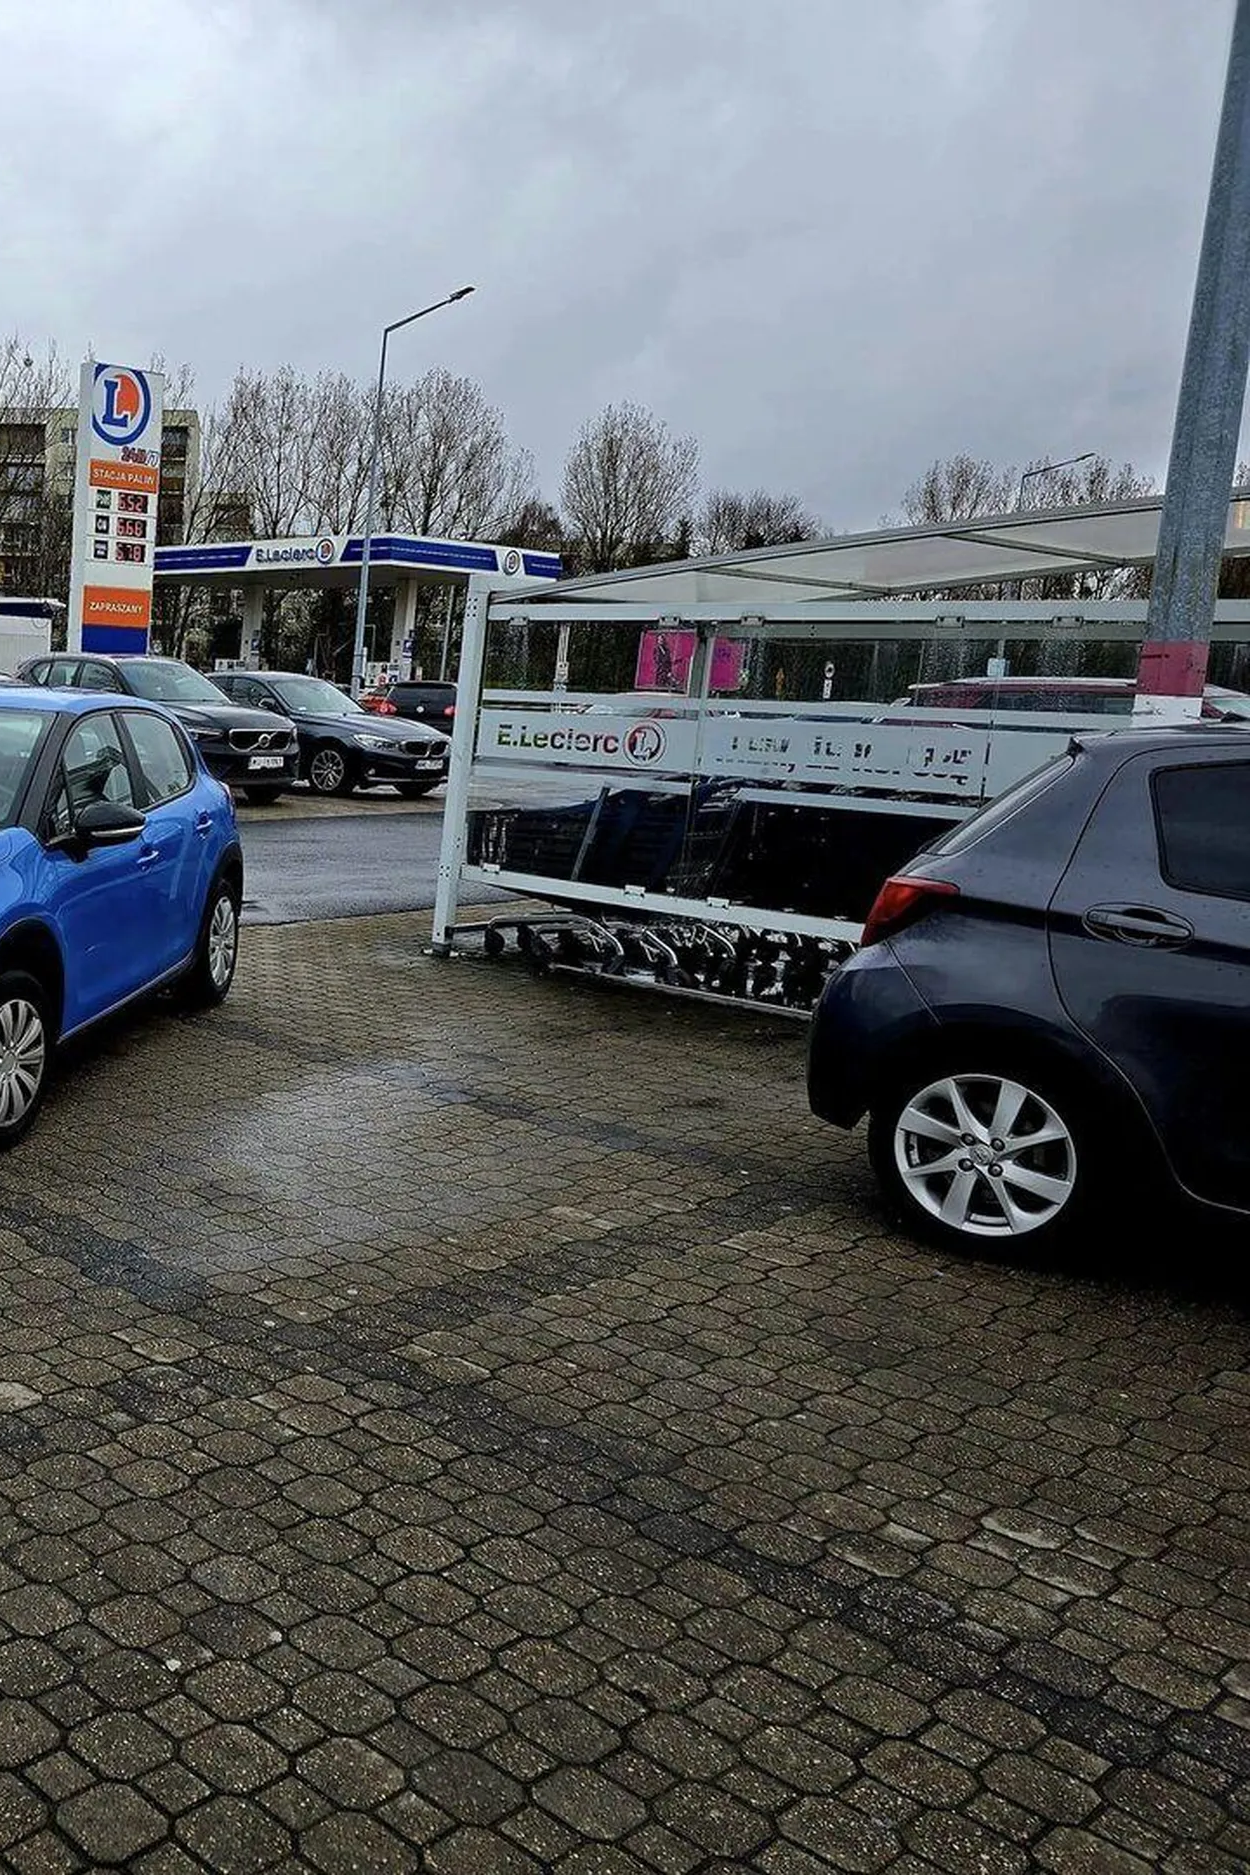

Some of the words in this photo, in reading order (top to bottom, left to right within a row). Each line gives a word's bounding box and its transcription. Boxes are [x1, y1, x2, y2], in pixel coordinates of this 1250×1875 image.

[93, 469, 127, 481] STACJA
[256, 547, 316, 563] E.Leclerc
[497, 724, 620, 754] E.Leclerc
